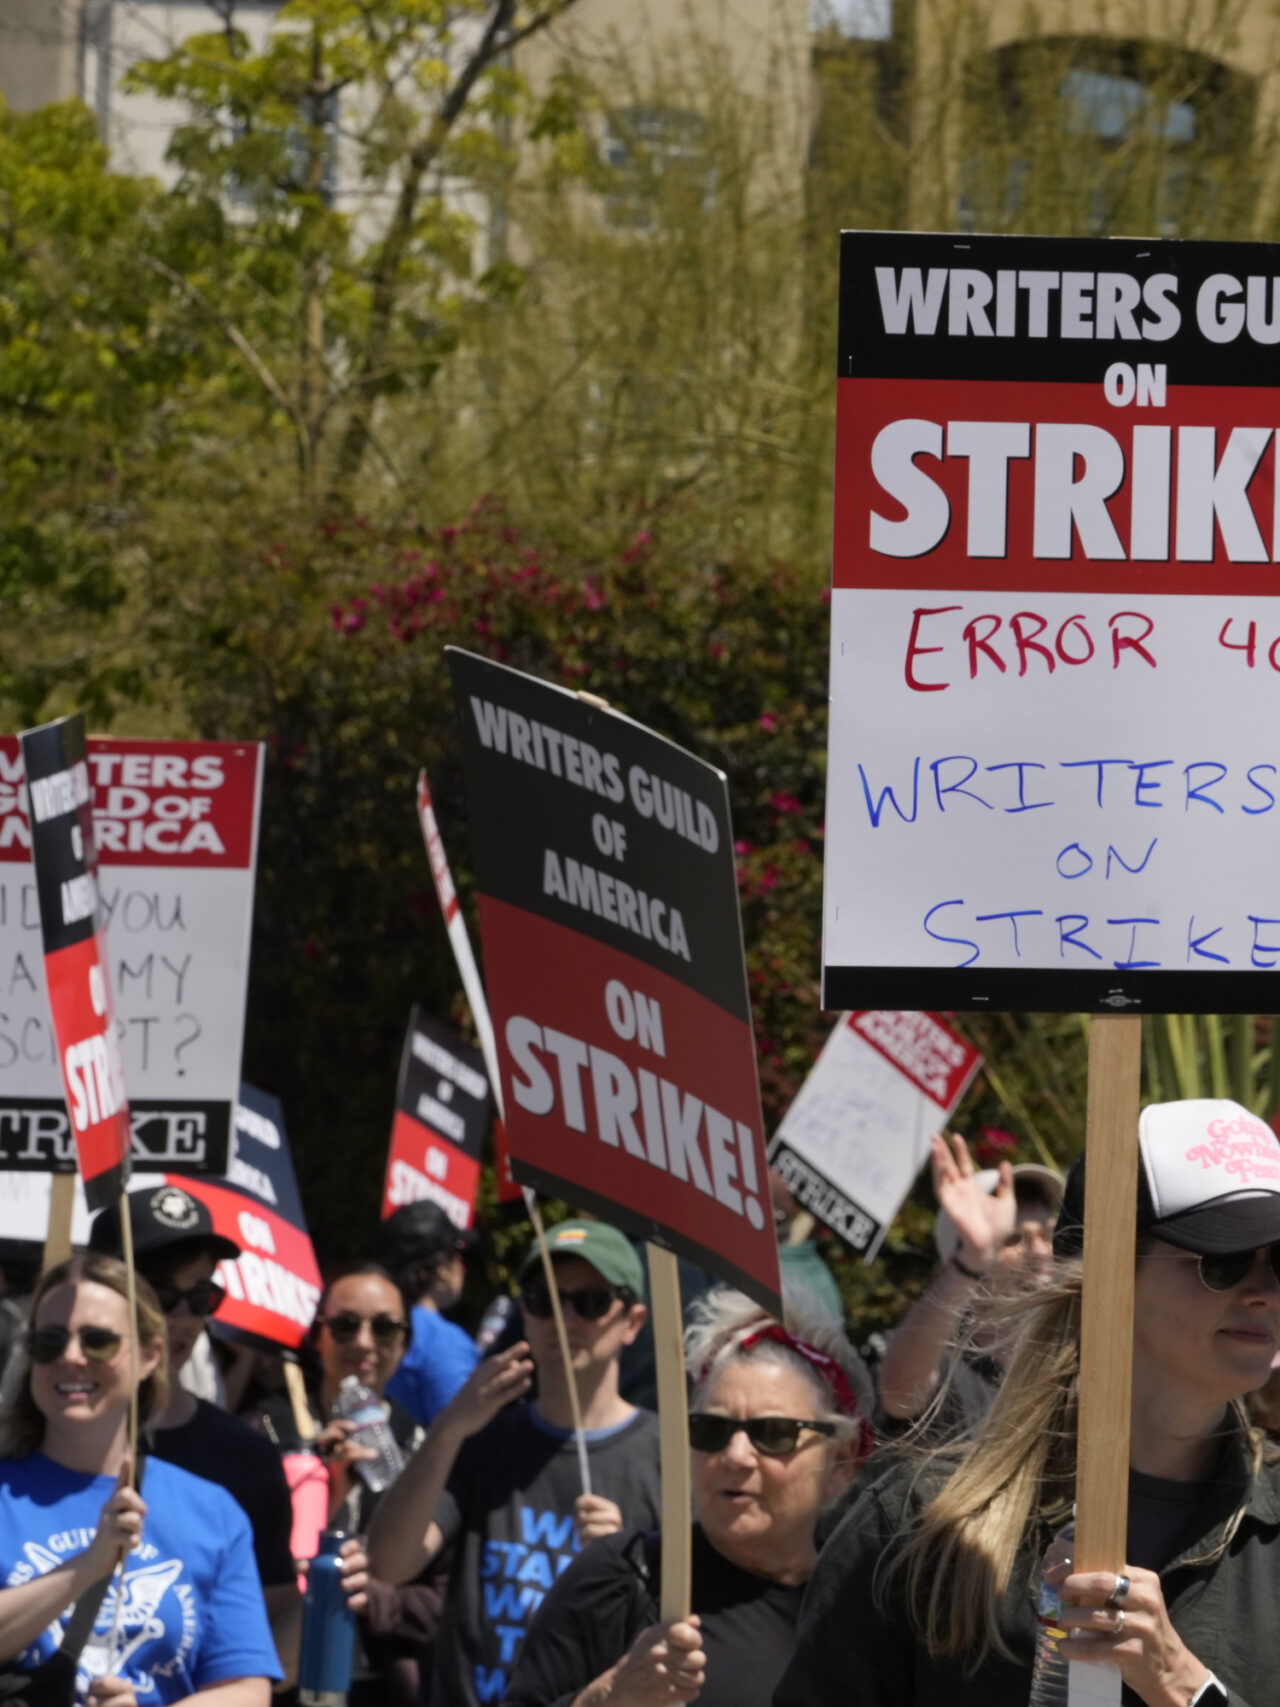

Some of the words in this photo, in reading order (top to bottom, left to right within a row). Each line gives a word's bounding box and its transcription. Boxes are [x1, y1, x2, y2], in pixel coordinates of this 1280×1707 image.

[875, 266, 1182, 341] WRITERS
[1103, 361, 1168, 407] ON
[904, 605, 1158, 692] ERROR
[152, 795, 212, 821] OF
[471, 697, 625, 803] WRITERS
[628, 764, 719, 854] GUILD
[858, 756, 1277, 828] WRITERS
[592, 812, 628, 862] OF
[1055, 838, 1158, 880] ON
[543, 849, 692, 962] AMERICA
[117, 952, 193, 1006] MY
[604, 978, 667, 1059] ON
[504, 1015, 766, 1233] STRIKE!
